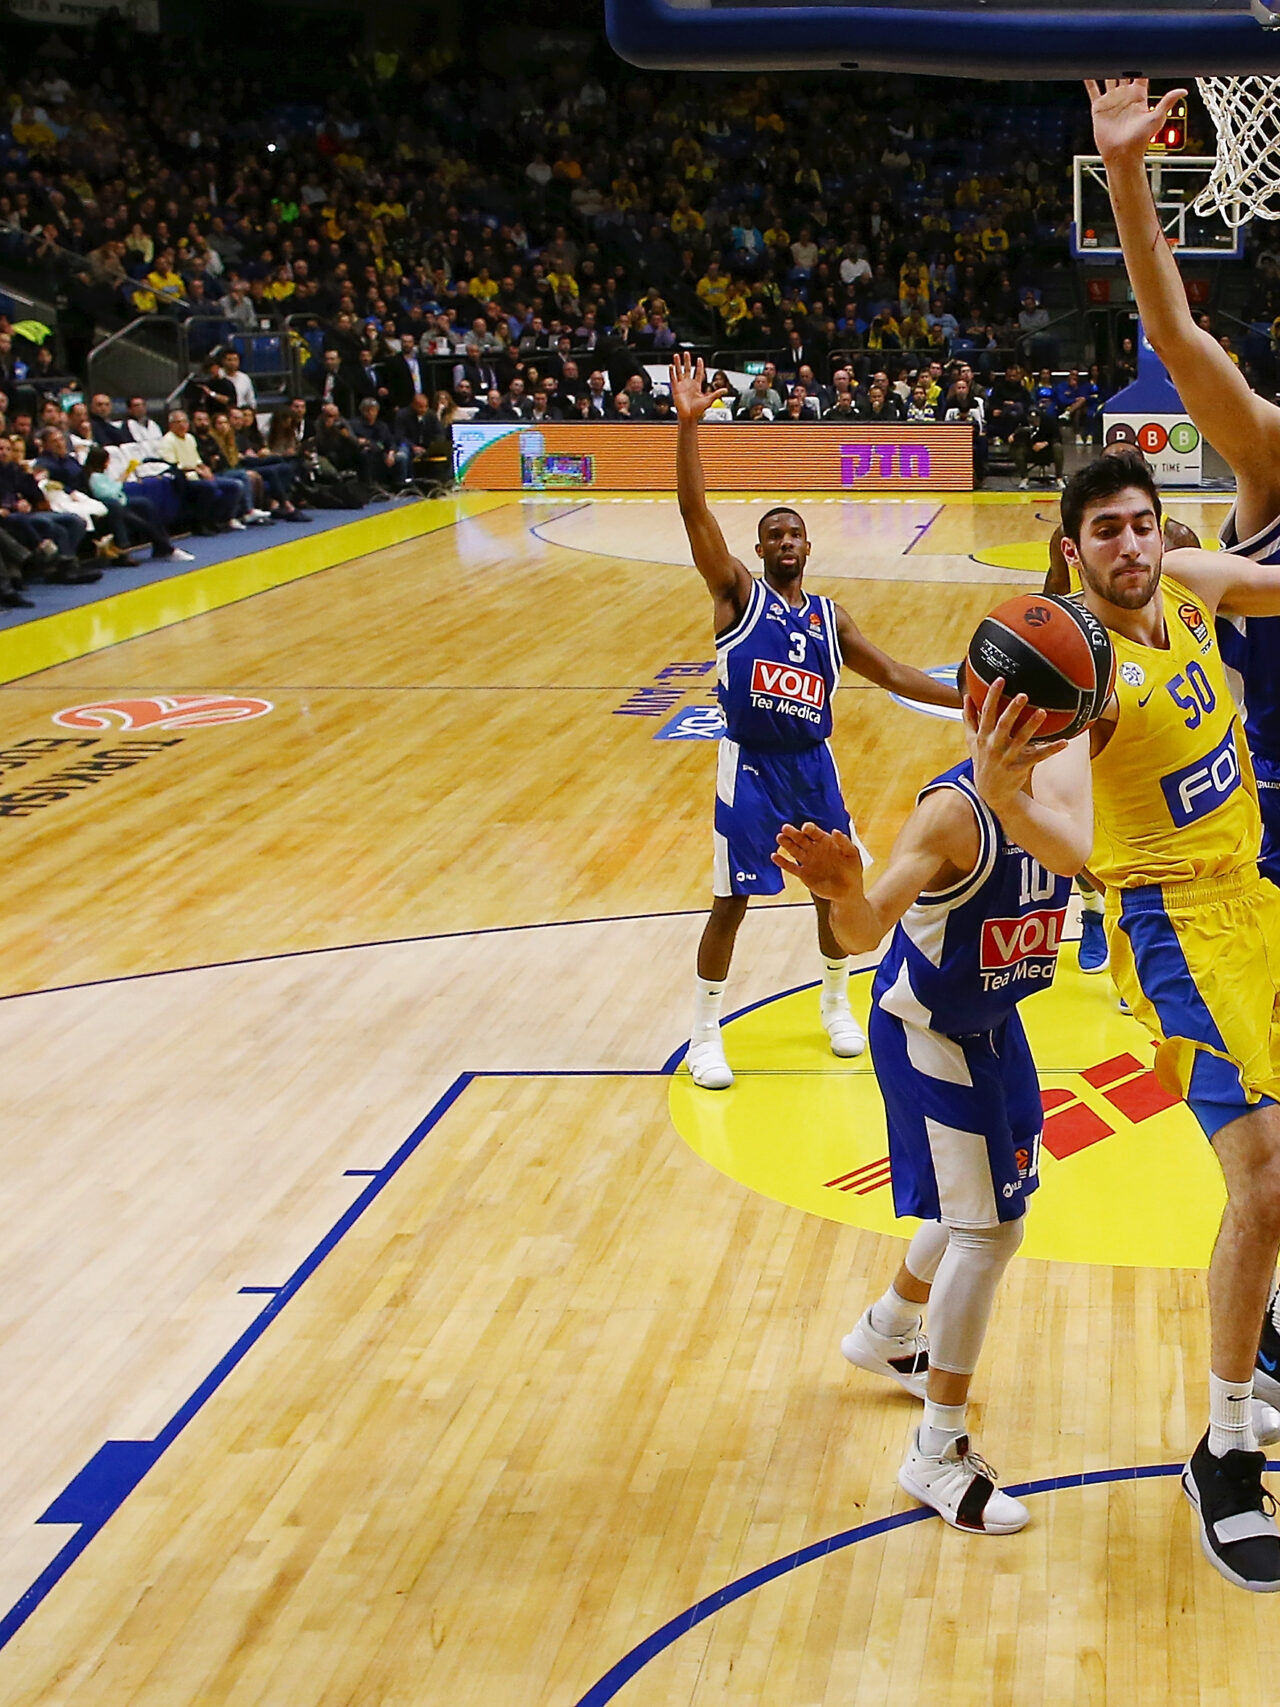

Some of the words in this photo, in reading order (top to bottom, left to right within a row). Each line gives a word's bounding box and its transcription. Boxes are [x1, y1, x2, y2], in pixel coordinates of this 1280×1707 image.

[788, 631, 807, 664] 3
[760, 664, 822, 703] VOLI
[1165, 660, 1216, 730] 50
[751, 693, 773, 711] Tea
[776, 700, 821, 724] Medica
[1019, 856, 1056, 906] 10
[991, 916, 1060, 962] VOL
[980, 972, 1009, 992] Tea
[1012, 961, 1055, 982] Med
